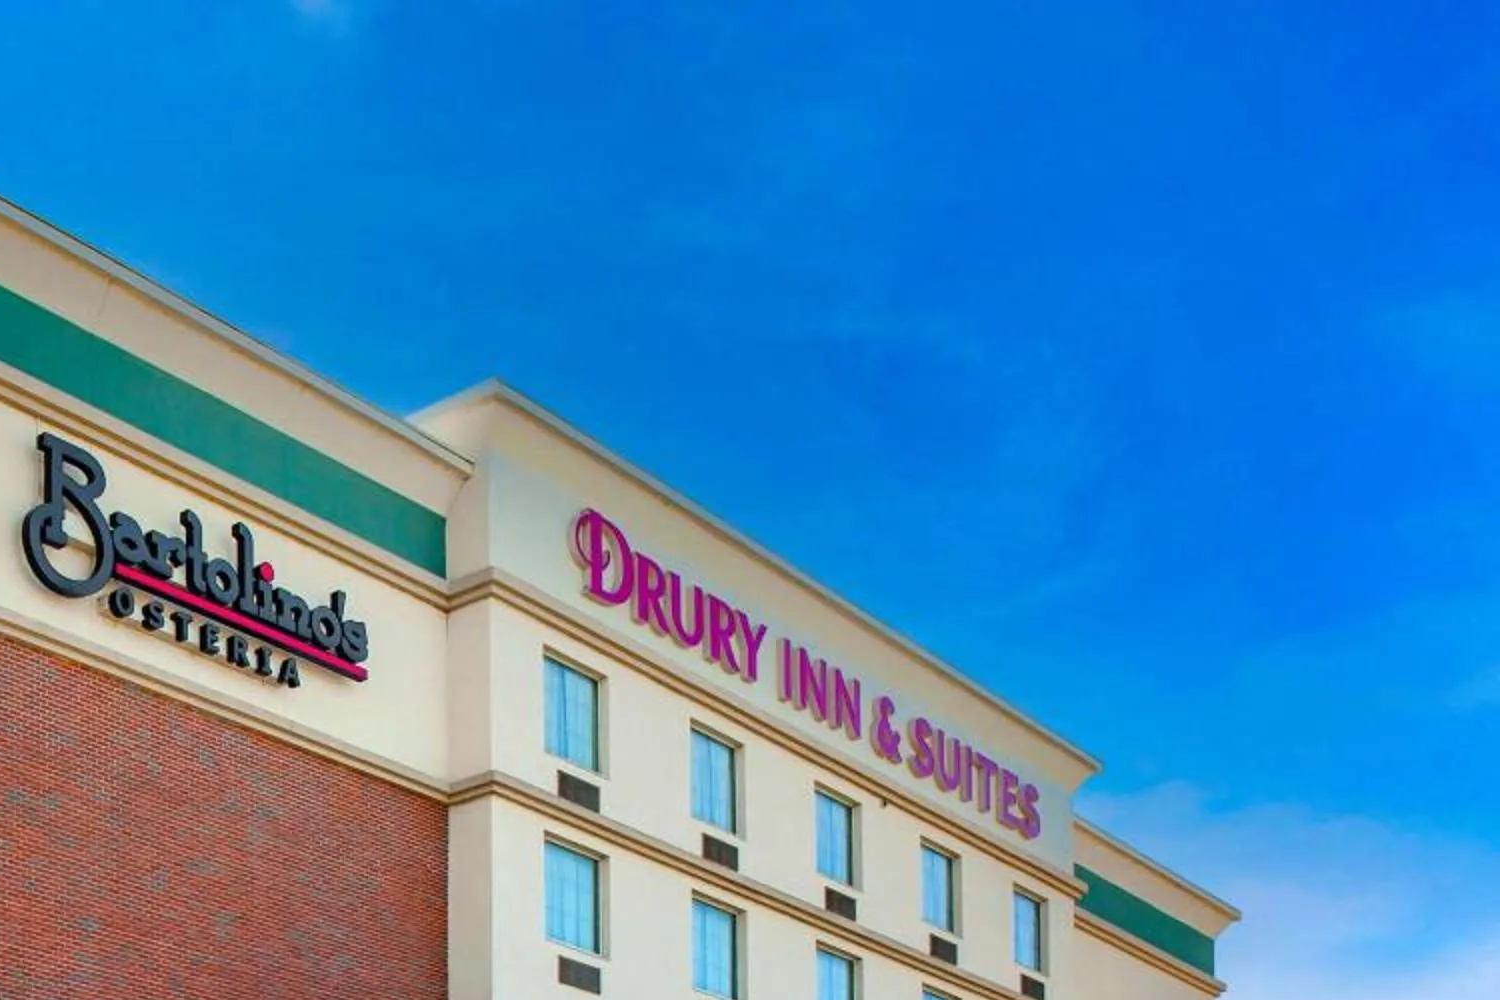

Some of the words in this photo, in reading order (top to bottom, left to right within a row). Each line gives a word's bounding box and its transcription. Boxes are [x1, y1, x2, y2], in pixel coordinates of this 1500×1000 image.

[22, 432, 369, 664] Bartolino's
[108, 588, 301, 688] OSTERIA
[571, 507, 768, 683] DRURY
[777, 637, 862, 741] INN
[869, 696, 904, 765] &
[907, 717, 1042, 841] SUITES
